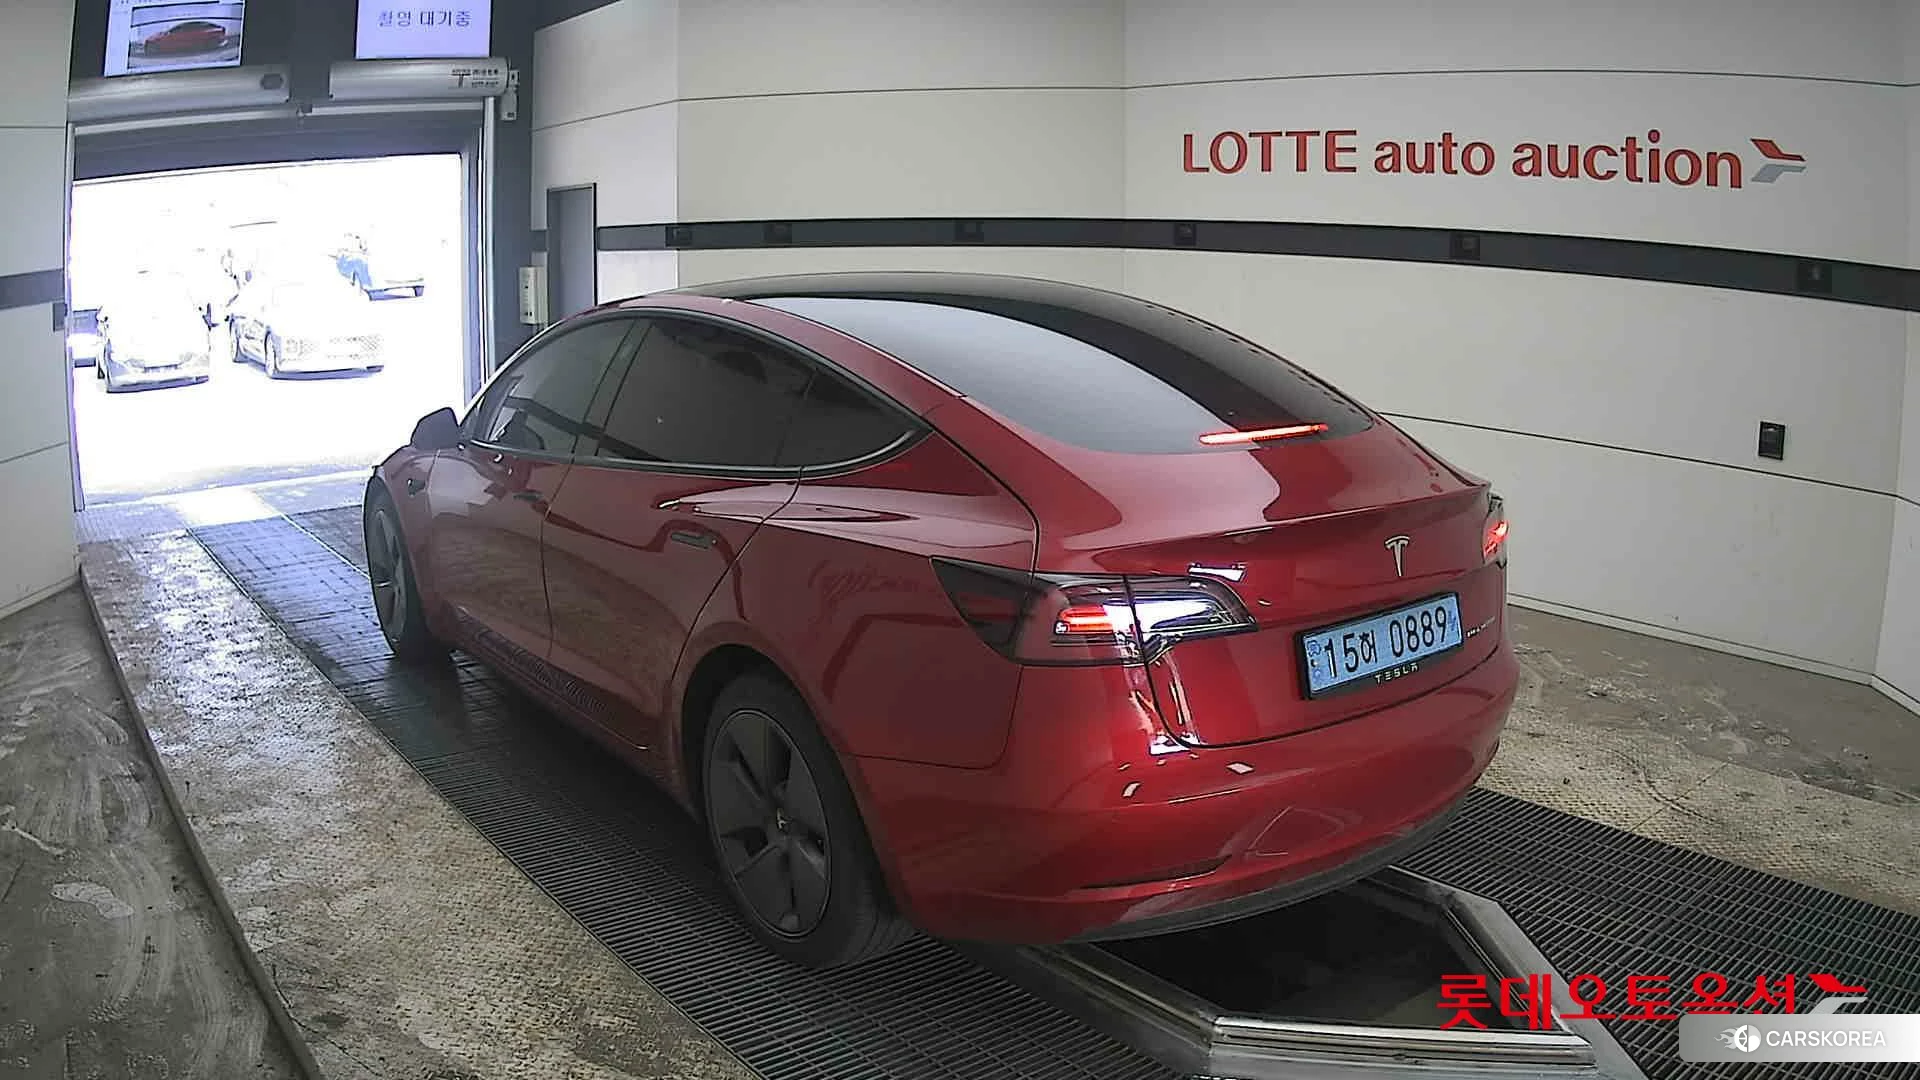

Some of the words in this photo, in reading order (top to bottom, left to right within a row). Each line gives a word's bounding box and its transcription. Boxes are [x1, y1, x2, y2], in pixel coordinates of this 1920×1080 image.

[420, 10, 472, 27] 대기중
[1183, 130, 1358, 174] LOTTE
[1374, 132, 1495, 177] auto
[1511, 129, 1742, 189] auction
[1389, 606, 1447, 658] 0889
[1375, 662, 1419, 684] TESLA
